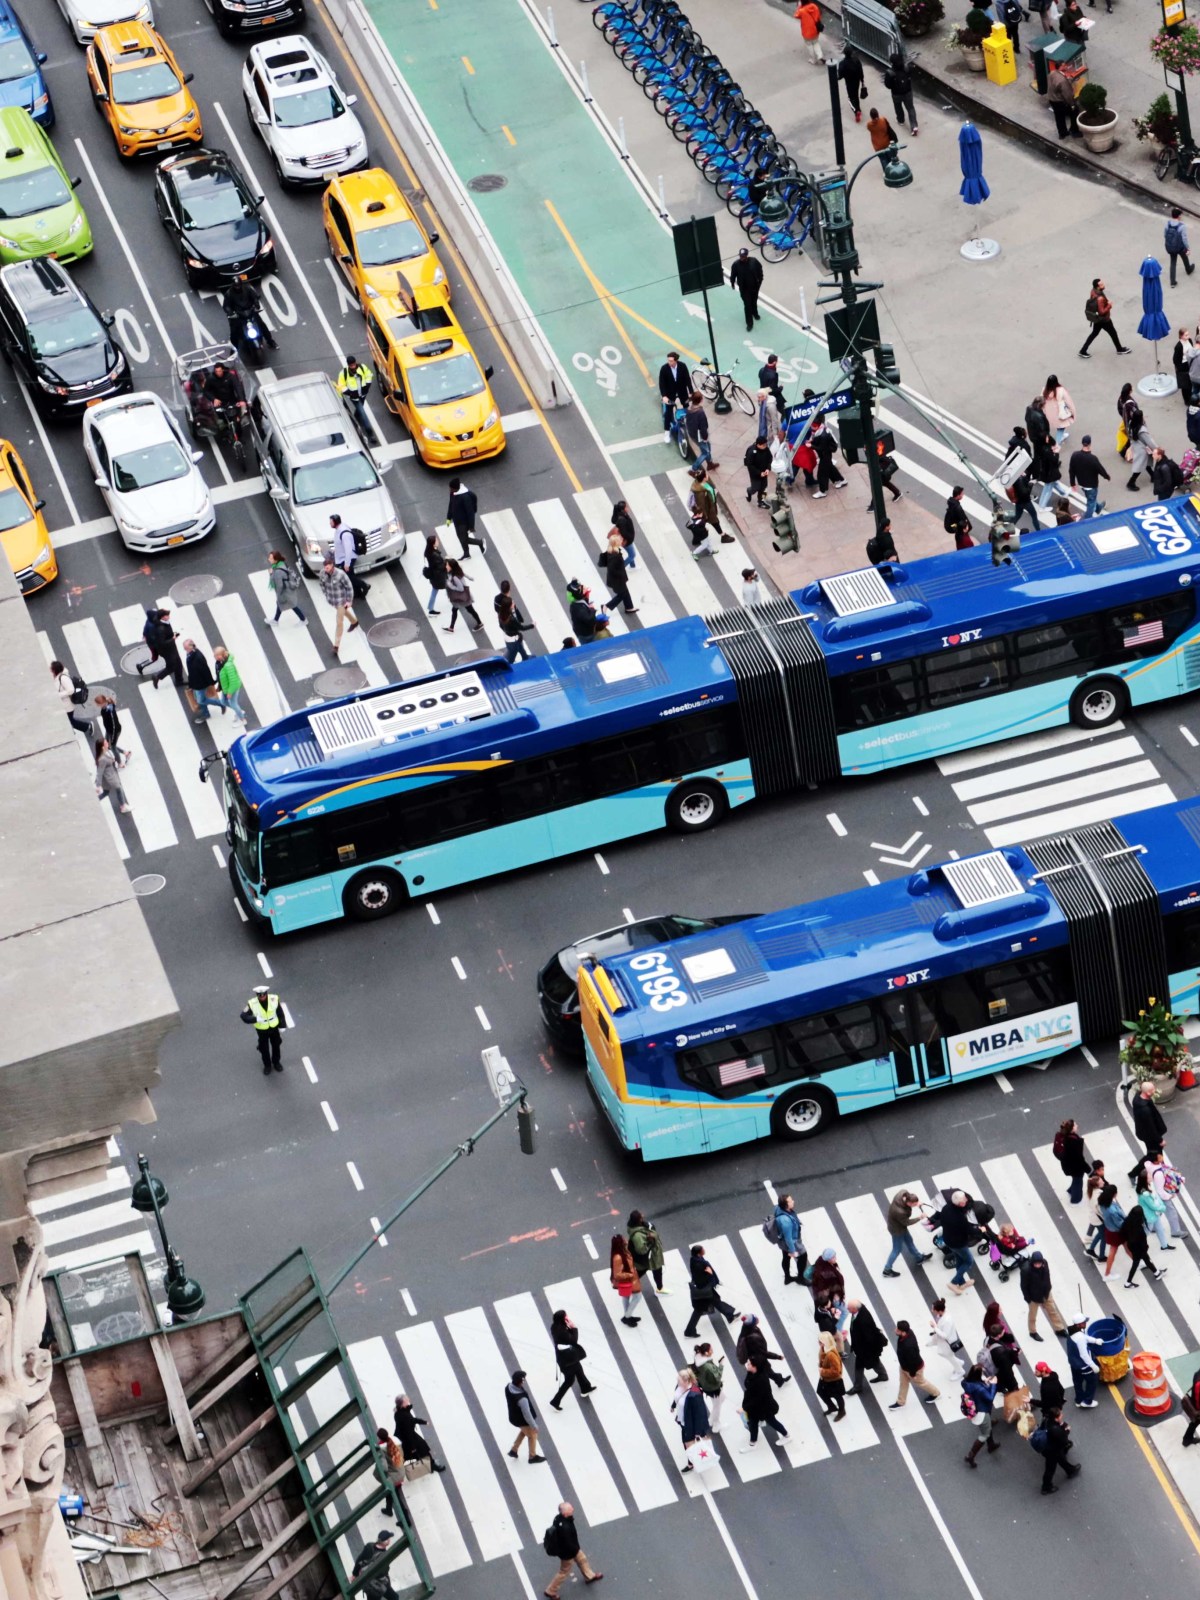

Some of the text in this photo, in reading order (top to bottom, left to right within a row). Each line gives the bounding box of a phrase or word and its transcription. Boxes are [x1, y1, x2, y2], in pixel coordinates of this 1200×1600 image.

[791, 405, 815, 420] West
[819, 398, 834, 412] 4th
[836, 395, 848, 406] St
[1134, 505, 1192, 556] 6226
[941, 636, 950, 648] I
[629, 952, 688, 1013] 6193
[886, 977, 895, 990] I
[688, 1033, 701, 1041] New
[701, 1029, 713, 1037] York
[713, 1026, 725, 1034] City
[725, 1023, 737, 1031] Bus
